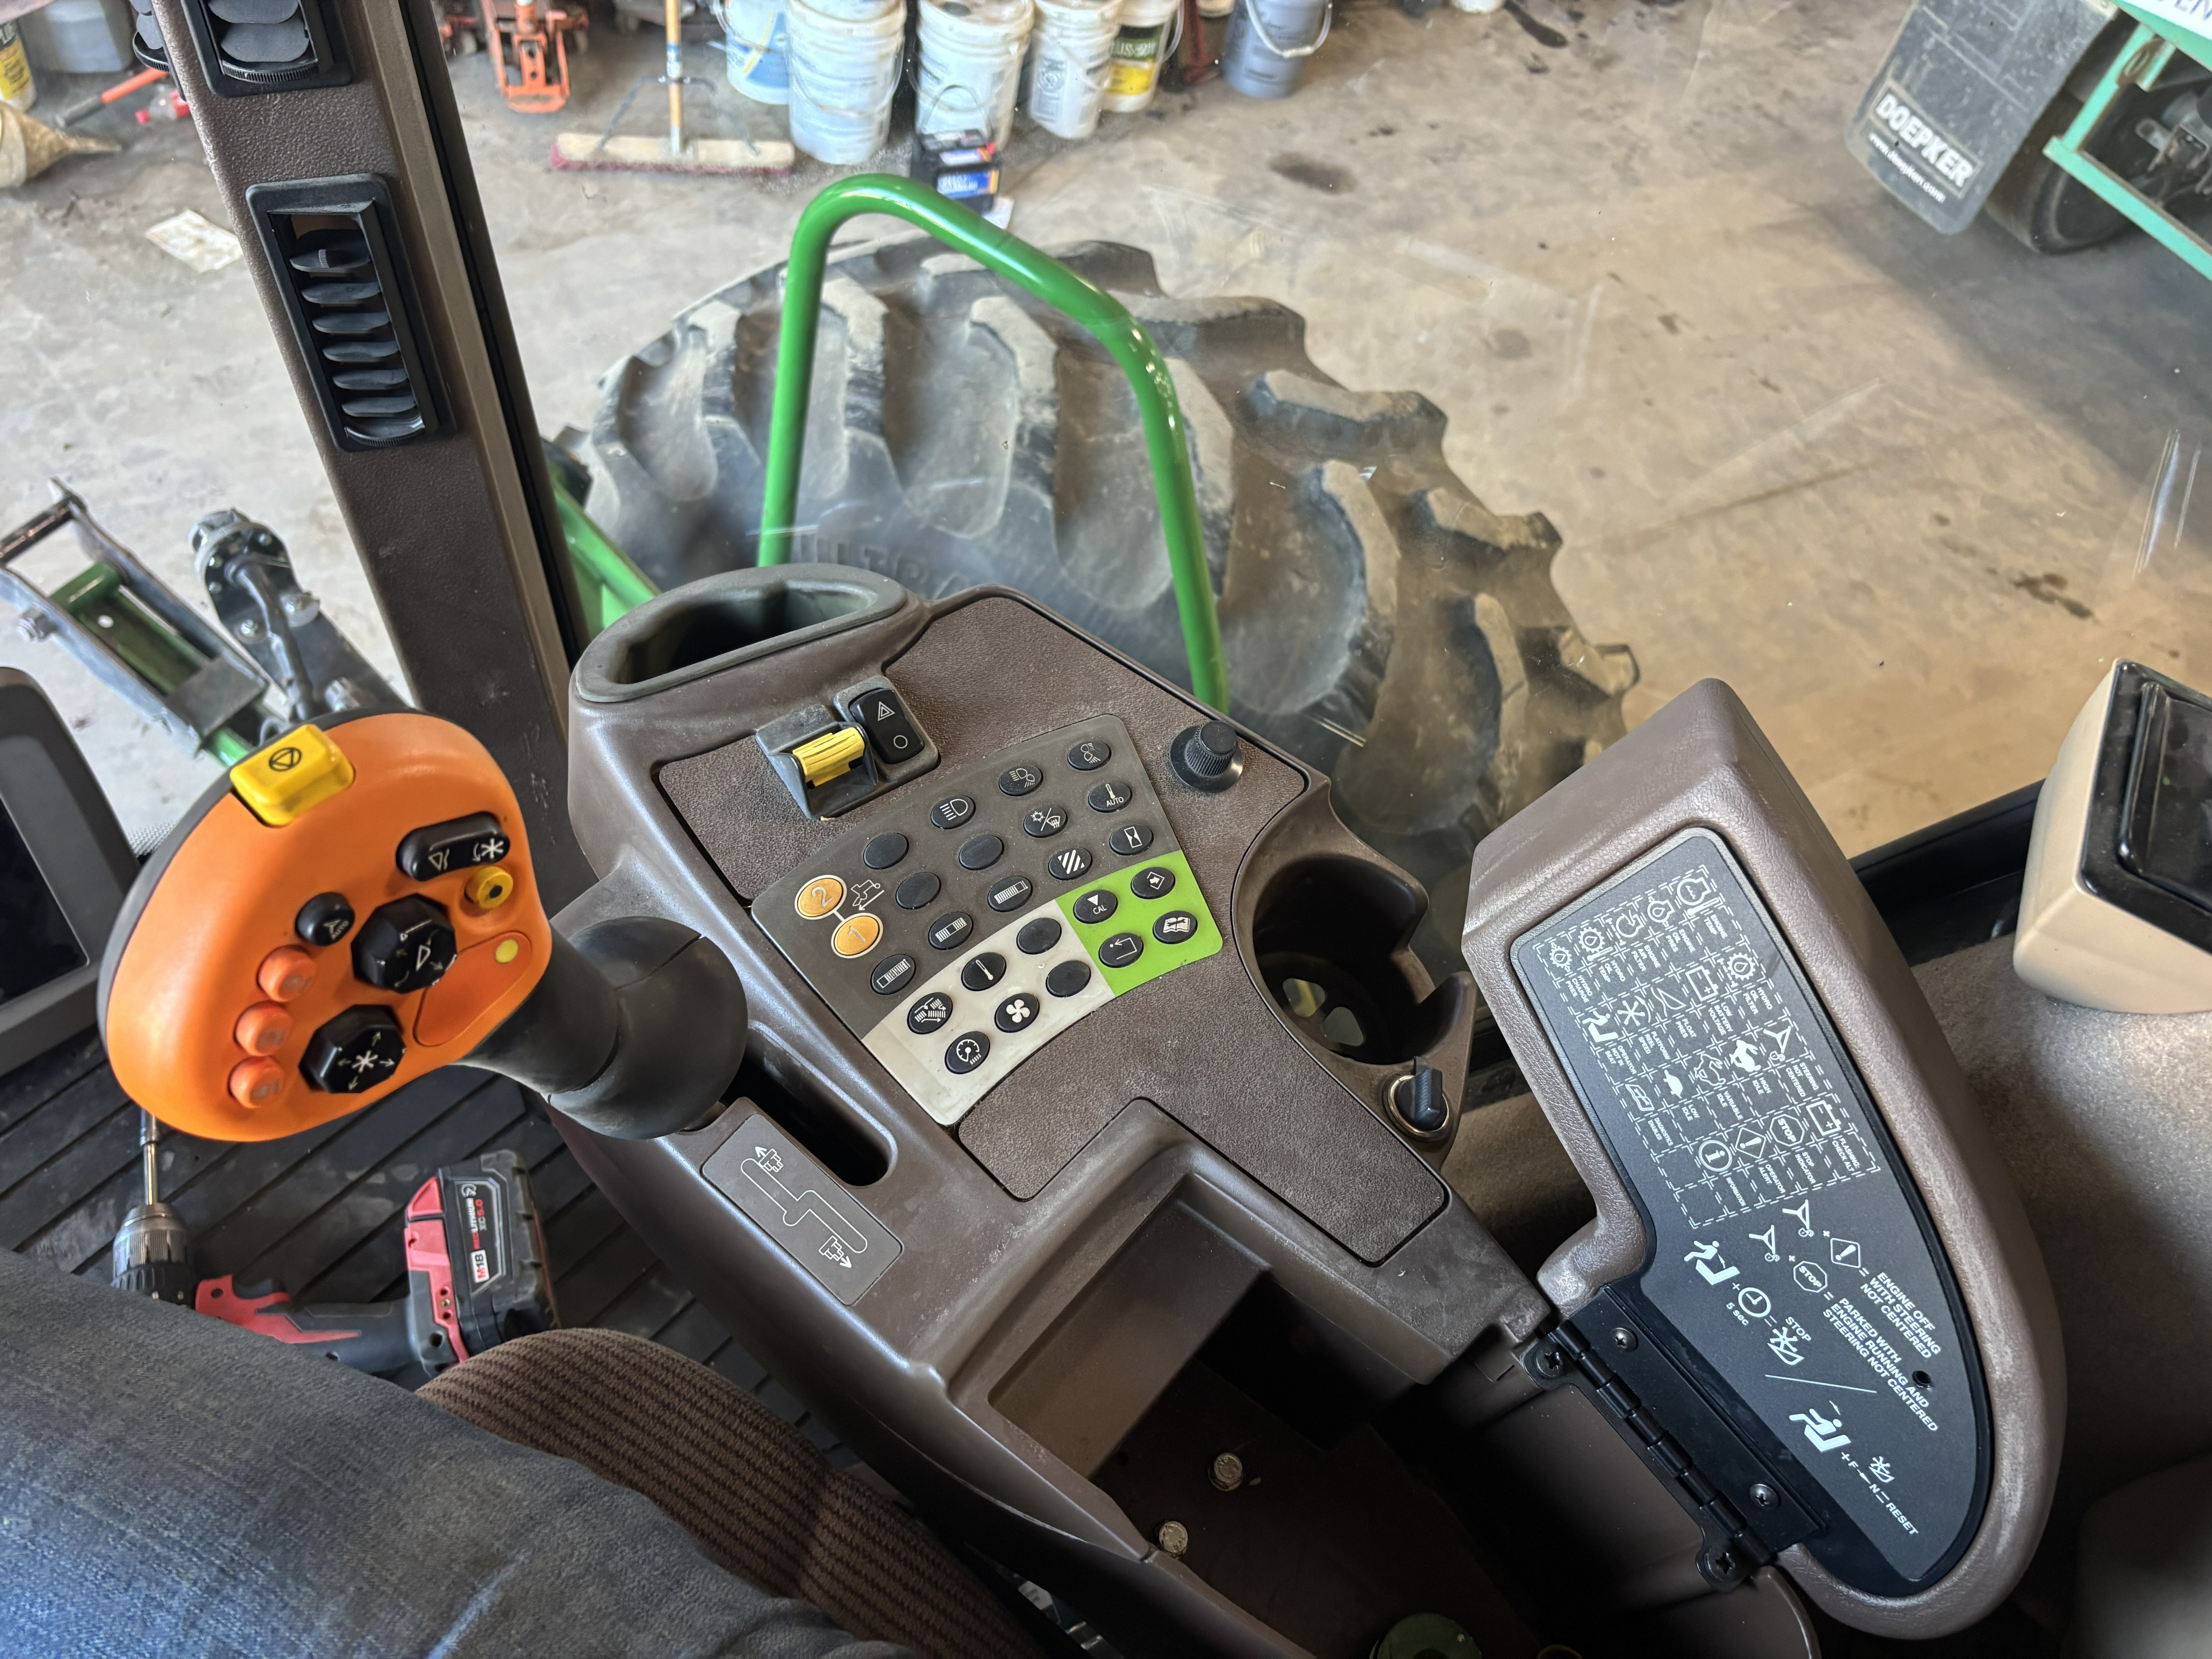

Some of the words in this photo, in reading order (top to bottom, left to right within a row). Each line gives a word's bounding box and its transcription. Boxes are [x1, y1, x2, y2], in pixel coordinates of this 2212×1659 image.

[1875, 93, 1973, 187] DOEPKER
[1106, 797, 1124, 807] AUTO
[811, 886, 833, 907] 2
[1093, 904, 1107, 915] CAL
[847, 926, 866, 942] 1
[1704, 917, 1717, 934] TEMP
[1711, 914, 1728, 938] ENGINE
[1666, 935, 1678, 952] PRES
[1673, 932, 1681, 943] OIL
[1679, 929, 1695, 953] ENGINE
[1631, 951, 1646, 971] FILTER
[1638, 949, 1647, 959] AIR
[1644, 945, 1661, 968] ENGINE
[1599, 965, 1611, 982] TEMP
[1604, 963, 1613, 974] OIL
[1610, 960, 1626, 982] HYDRO
[1565, 981, 1578, 997] PRES
[1572, 978, 1589, 1003] CHARGE
[1577, 975, 1592, 996] HYDRO
[1750, 990, 1759, 1001] OIL
[1721, 1002, 1733, 1016] LOW
[1743, 993, 1758, 1014] FILTER
[1757, 987, 1772, 1010] HYDRO
[1682, 1018, 1697, 1037] FLOAT
[1708, 1007, 1726, 1036] VOLTAGE
[1714, 1005, 1733, 1032] BATTERY
[1675, 1021, 1688, 1038] PRES
[1638, 1036, 1651, 1054] SPEED
[1645, 1034, 1655, 1048] REEL
[1605, 1051, 1616, 1064] SEAT
[1611, 1048, 1621, 1059] NOT
[1618, 1045, 1637, 1074] OPERATOR
[1793, 1065, 1803, 1076] NOT
[1800, 1062, 1819, 1090] STEERING
[1752, 1080, 1764, 1095] IDLE
[1759, 1077, 1771, 1094] HIGH
[1786, 1068, 1806, 1097] CENTERED
[1688, 1104, 1700, 1118] LOW
[1717, 1093, 1728, 1108] IDLE
[1724, 1091, 1743, 1120] VARIABLE
[1682, 1106, 1693, 1121] IDLE
[1648, 1120, 1662, 1140] ENABLED
[1654, 1117, 1673, 1146] DIAGNOSTICS
[1778, 1118, 1796, 1142] STOP
[1802, 1152, 1814, 1166] STOP
[1832, 1140, 1848, 1161] CHECK
[1844, 1162, 1855, 1171] ALT
[1758, 1167, 1772, 1183] ALERT
[1765, 1164, 1785, 1193] OPERATOR
[1795, 1154, 1815, 1184] INDICATOR
[1726, 1177, 1746, 1206] INFORMATION
[466, 1198, 481, 1250] LITHIUM
[475, 1254, 486, 1280] M18
[1799, 1266, 1822, 1287] STOP
[1877, 1272, 1915, 1310] ENGINE
[1913, 1310, 1935, 1330] OFF
[1733, 1310, 1748, 1326] sec
[1860, 1284, 1884, 1304] NOT
[1881, 1305, 1931, 1358] CENTERED
[1870, 1278, 1896, 1304] WITH
[1893, 1304, 1941, 1354] STEERING
[1786, 1317, 1811, 1341] STOP
[1839, 1298, 1878, 1337] PARKED
[1876, 1336, 1902, 1363] WITH
[1831, 1304, 1868, 1341] ENGINE
[1865, 1340, 1908, 1385] RUNNING
[1905, 1387, 1929, 1407] AND
[1823, 1309, 1869, 1357] STEERING
[1867, 1357, 1890, 1377] NOT
[1887, 1379, 1938, 1431] CENTERED
[1886, 1503, 1918, 1534] RESET
